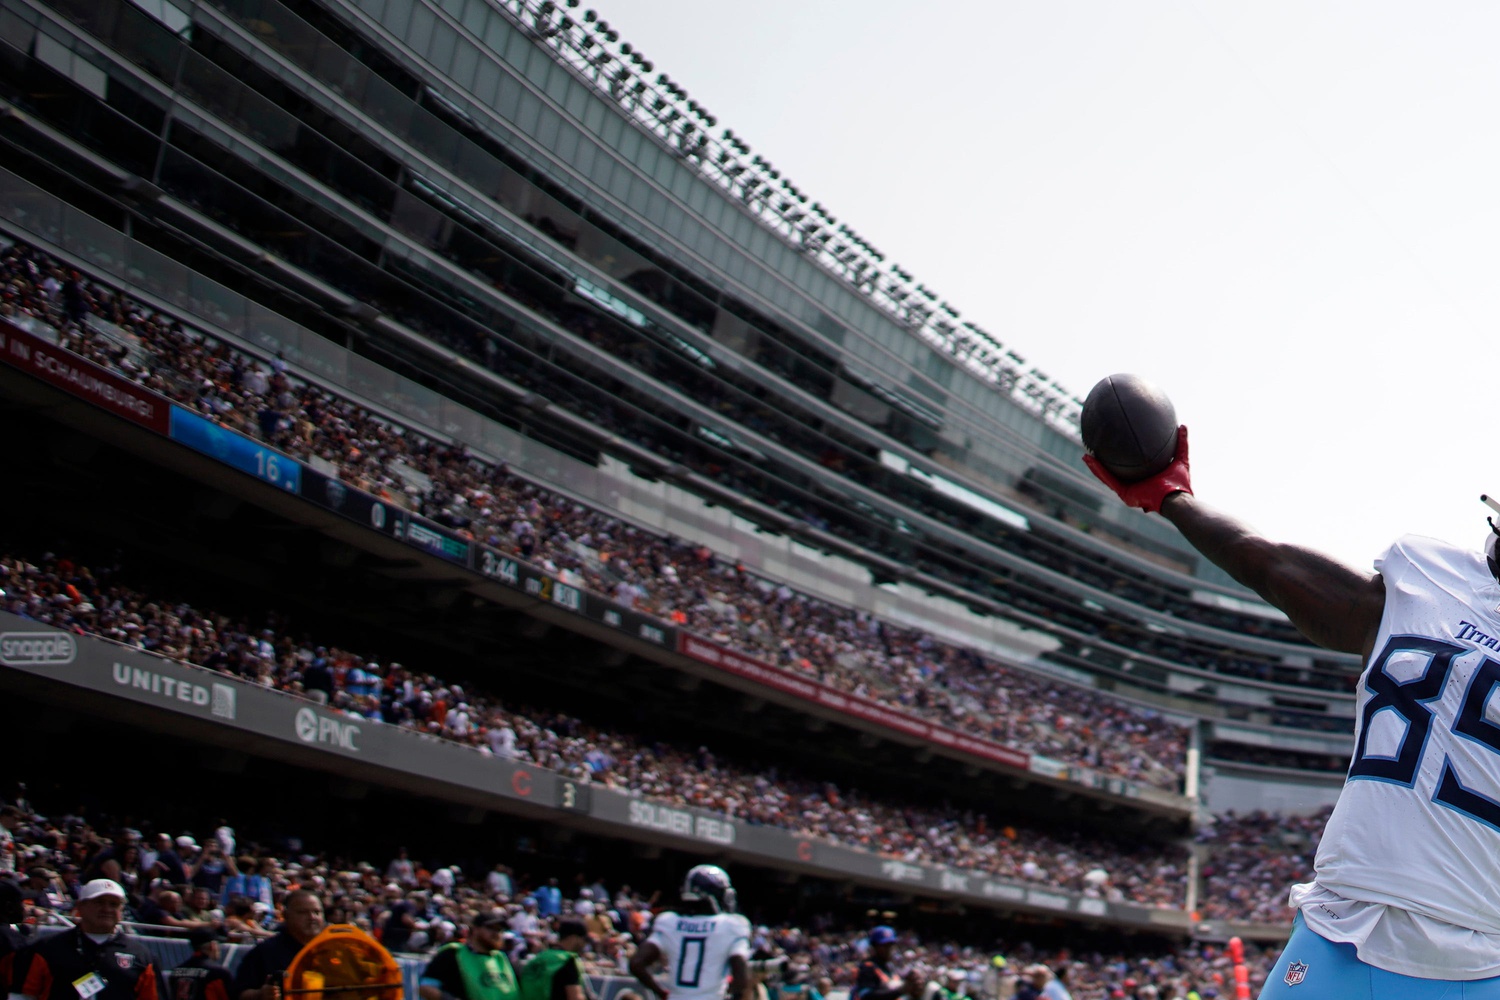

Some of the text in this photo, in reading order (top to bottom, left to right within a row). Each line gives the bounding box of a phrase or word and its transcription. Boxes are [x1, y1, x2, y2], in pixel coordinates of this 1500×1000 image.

[10, 338, 154, 420] IN SCHAUMBURG!
[254, 450, 281, 481] 16
[371, 502, 386, 529] 0
[1, 637, 71, 661] snapple
[112, 662, 210, 706] UNITED
[318, 716, 362, 751] PNC
[629, 799, 738, 845] SOLDIER FIELD
[676, 936, 707, 989] 0
